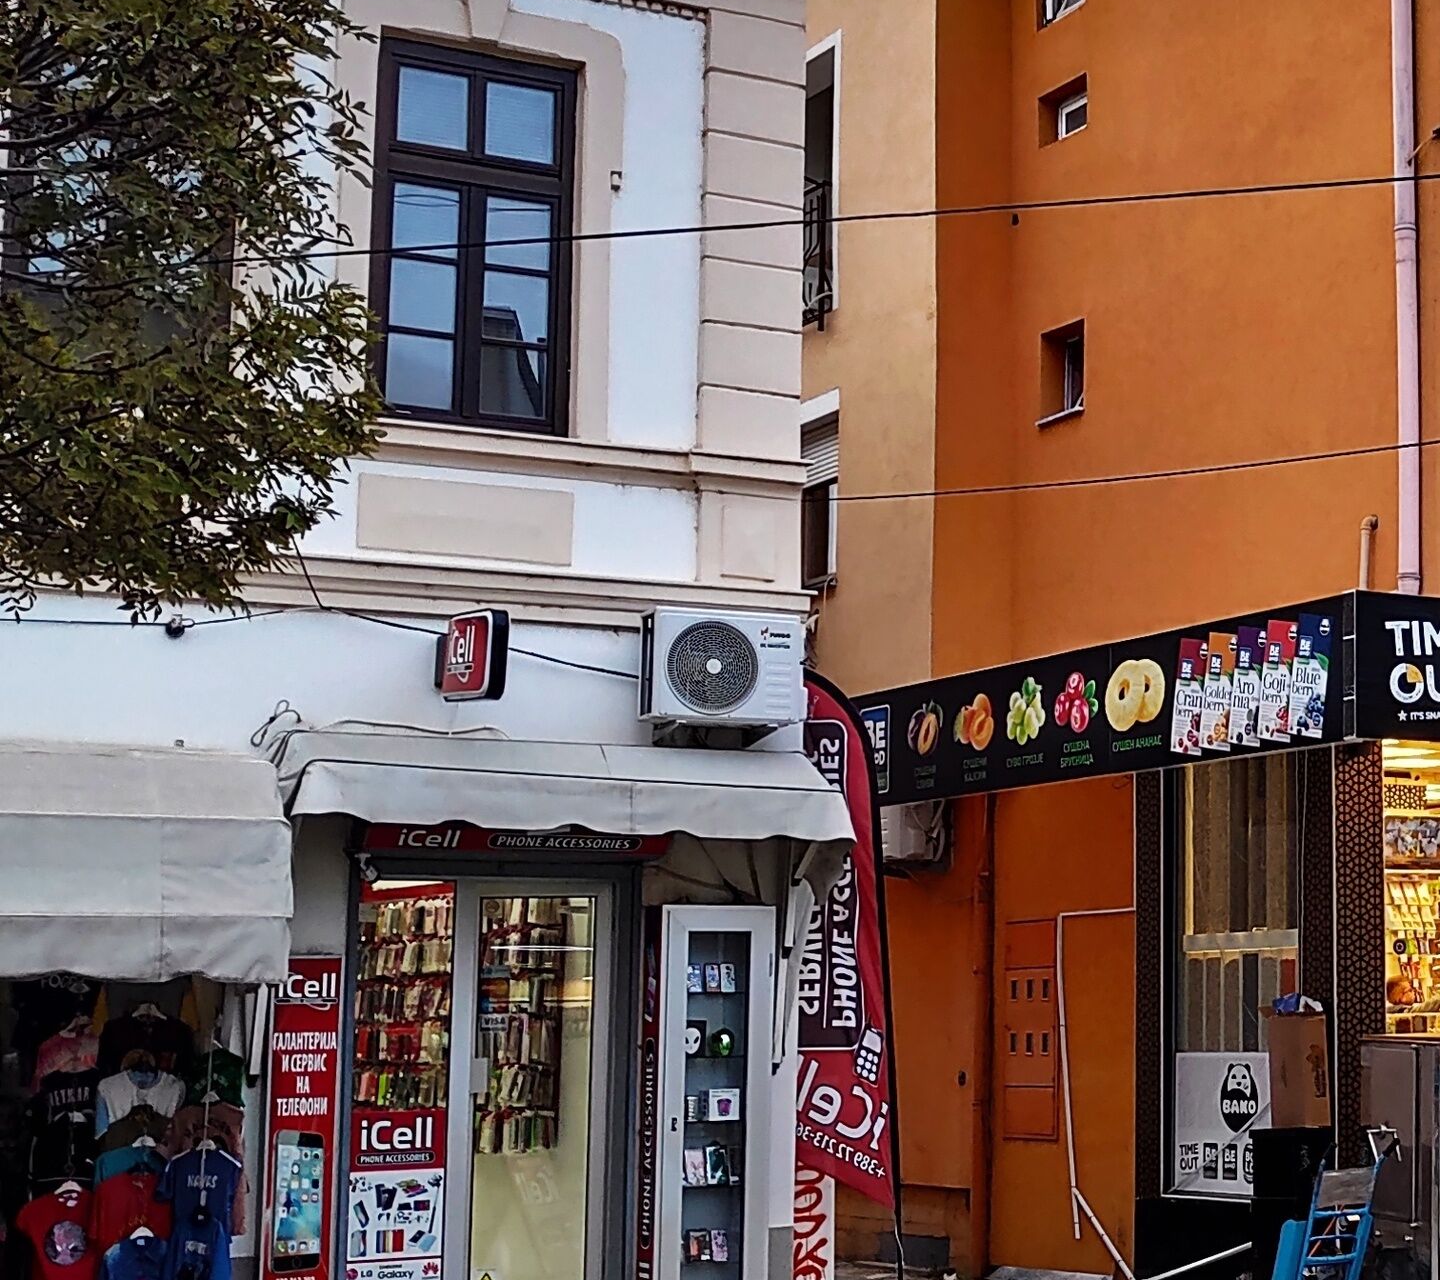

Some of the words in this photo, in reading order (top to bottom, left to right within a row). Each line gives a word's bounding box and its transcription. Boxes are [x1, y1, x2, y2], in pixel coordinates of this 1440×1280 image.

[1263, 672, 1287, 695] Goji
[1295, 667, 1321, 686] Blue
[398, 828, 460, 848] iCell
[496, 835, 543, 848] PHONE
[545, 837, 631, 850] ACCESSORIES
[484, 1017, 506, 1026] VISA
[273, 1032, 337, 1050] ГАЛАНТЕРИЈА
[282, 1054, 289, 1072] И
[291, 1053, 327, 1072] СЕРВИС
[296, 1076, 310, 1094] НА
[277, 1097, 328, 1116] ТЕЛЕФОНИ
[643, 1051, 655, 1169] ACCESSORIES
[1222, 1099, 1257, 1114] BAKO
[361, 1116, 433, 1151] iCell
[360, 1155, 384, 1164] PHONE
[385, 1153, 430, 1163] ACCESSORIES
[1180, 1156, 1199, 1170] OUT
[1224, 1148, 1236, 1162] BE
[641, 1176, 652, 1236] PHONE
[361, 1270, 373, 1278] LG
[377, 1270, 414, 1280] Galaxy
